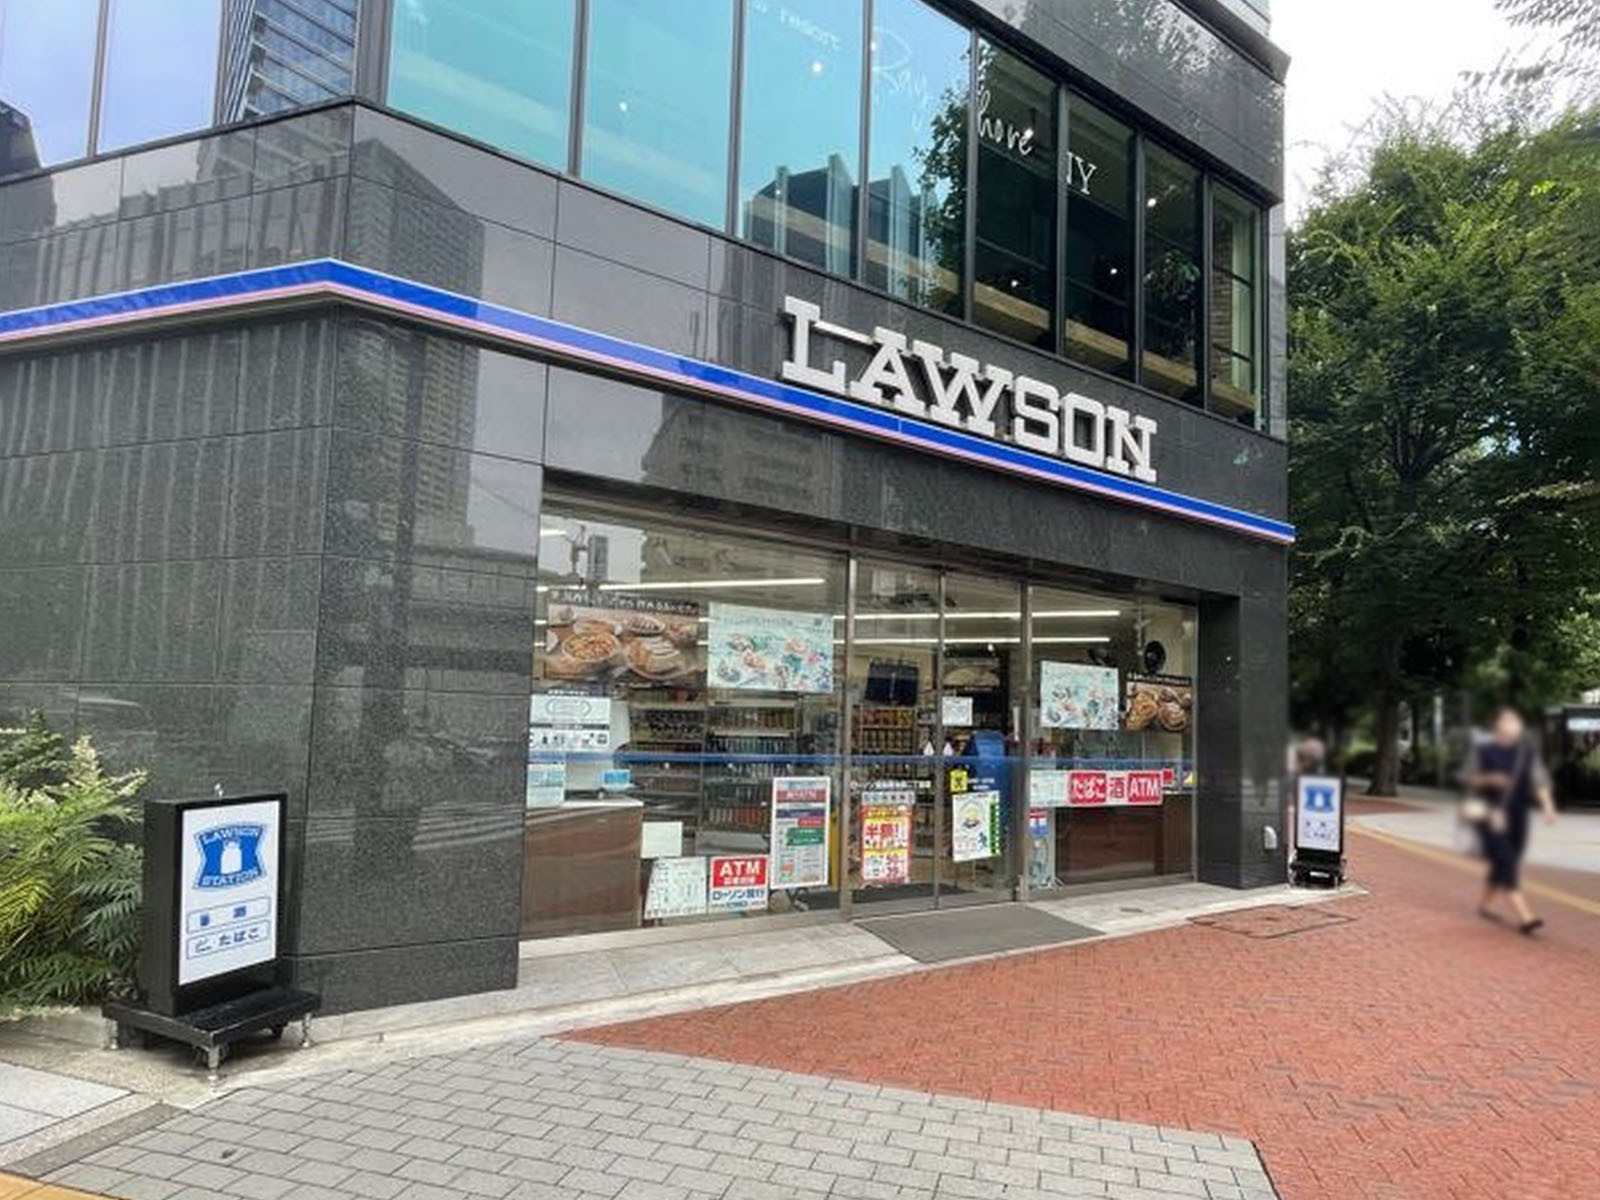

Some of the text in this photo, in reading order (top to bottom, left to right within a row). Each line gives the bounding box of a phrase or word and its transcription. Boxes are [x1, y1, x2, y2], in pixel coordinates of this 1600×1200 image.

[782, 295, 1157, 482] LAWSON
[1073, 774, 1105, 799] たばこ
[1129, 776, 1159, 797] ATM
[201, 825, 261, 845] LAWSON
[200, 869, 260, 887] STATION
[719, 860, 760, 877] ATM
[218, 928, 260, 947] たばこ
